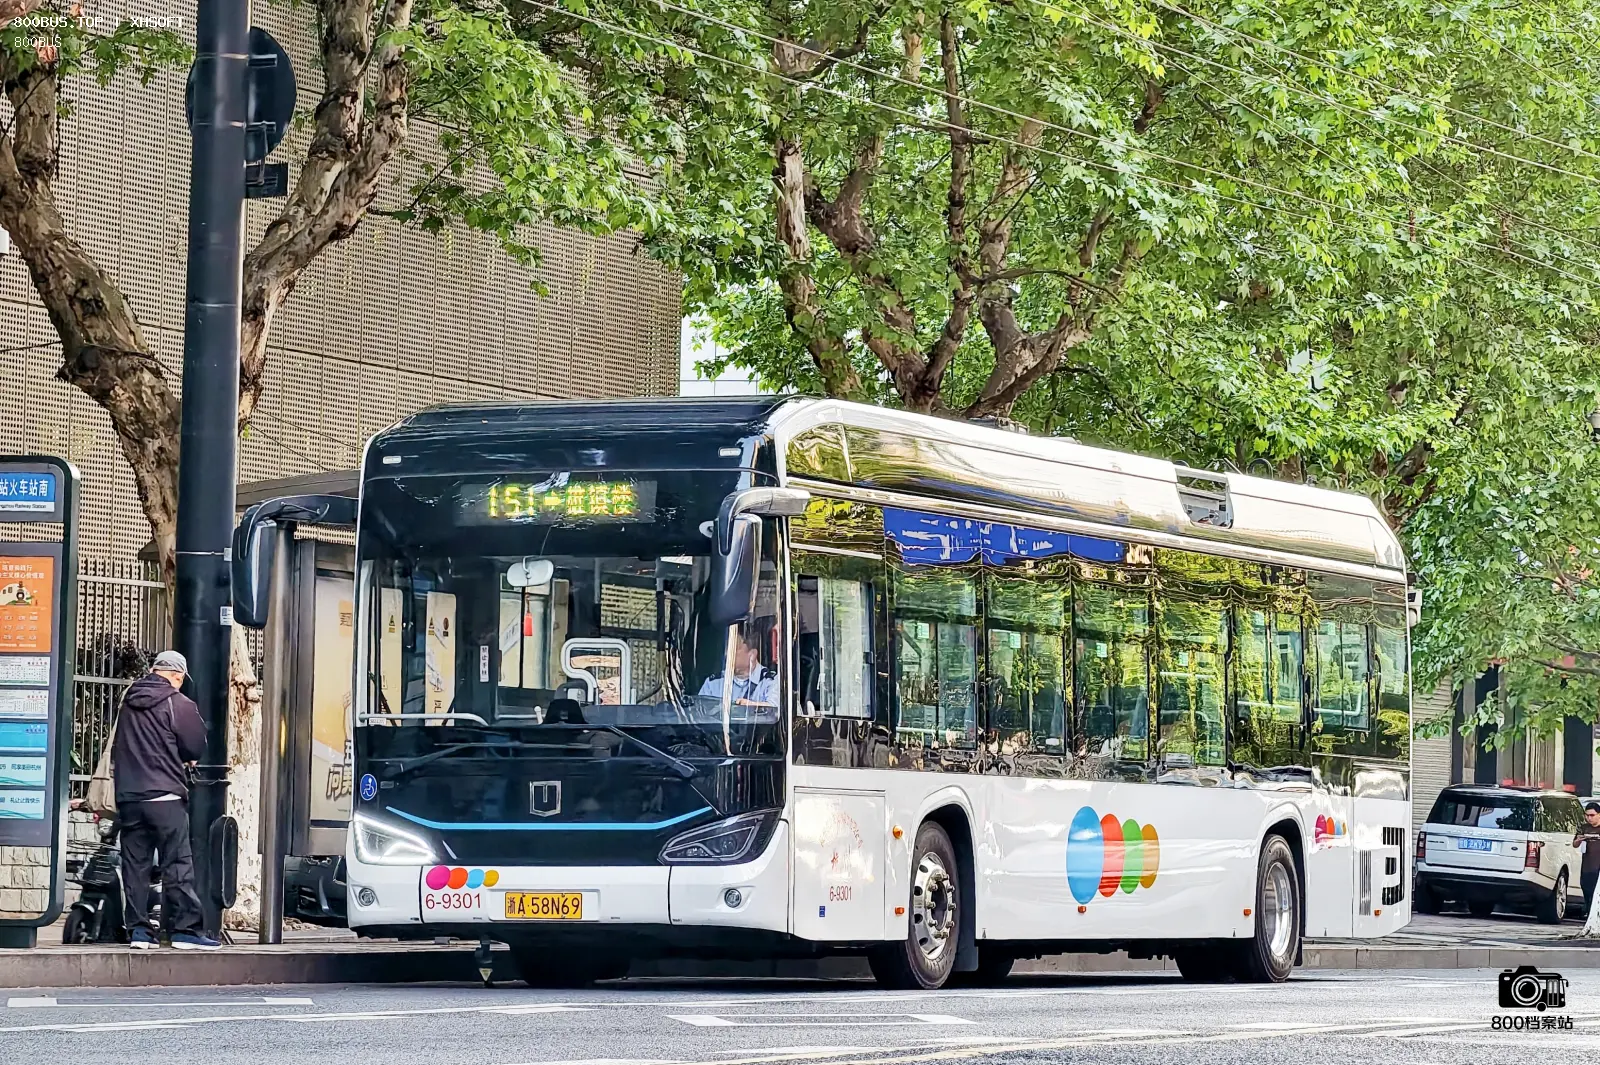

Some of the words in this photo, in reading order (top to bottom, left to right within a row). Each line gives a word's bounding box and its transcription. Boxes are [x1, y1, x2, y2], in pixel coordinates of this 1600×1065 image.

[0, 478, 49, 497] 站火车站南
[488, 485, 535, 517] 151
[425, 893, 482, 910] 6-9301
[829, 885, 852, 901] 6-9301
